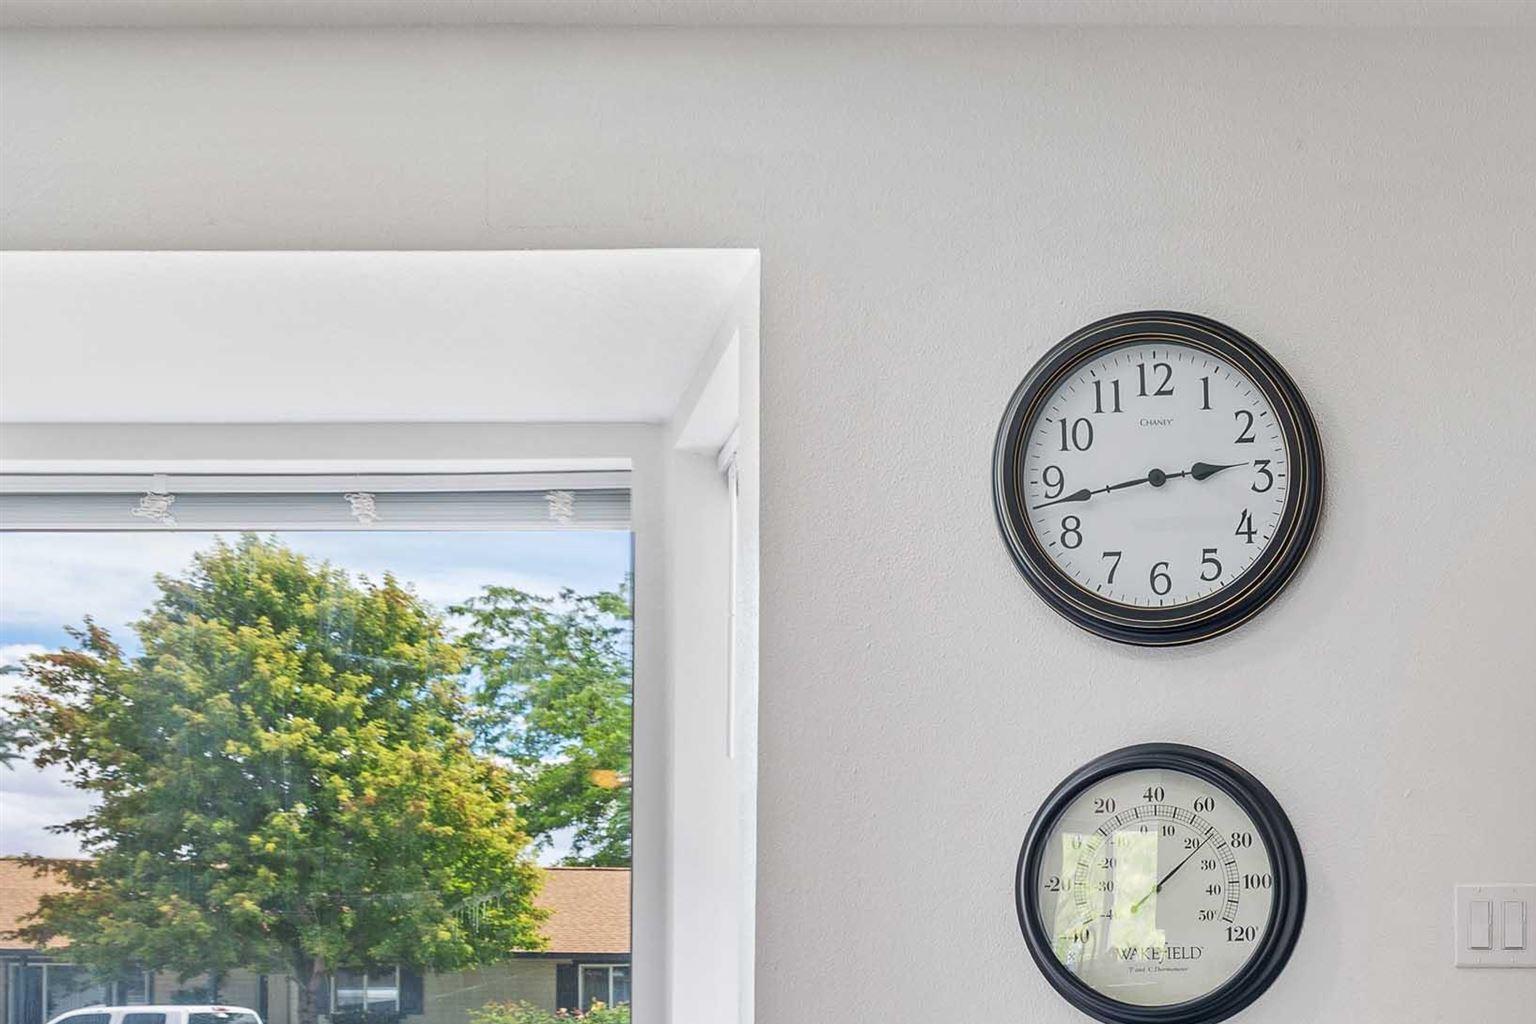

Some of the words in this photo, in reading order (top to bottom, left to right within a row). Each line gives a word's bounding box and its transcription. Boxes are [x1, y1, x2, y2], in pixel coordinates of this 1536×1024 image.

[1092, 379, 1123, 413] 11
[1136, 363, 1174, 396] 12
[1200, 377, 1212, 410] 1
[1058, 417, 1094, 451] 10
[1234, 410, 1256, 444] 2
[1042, 465, 1065, 499] 9
[1251, 459, 1273, 493] 3
[1060, 515, 1083, 549] 8
[1234, 508, 1258, 544] 4
[1102, 551, 1122, 584] 7
[1150, 562, 1172, 595] 6
[1200, 548, 1222, 581] 5
[1094, 798, 1115, 814] 20
[1143, 786, 1165, 802] 40
[1194, 796, 1215, 812] 60
[1162, 825, 1175, 836] 10
[1184, 838, 1200, 850] 20
[1230, 832, 1252, 848] 80
[1200, 860, 1216, 870] 30
[1243, 874, 1272, 889] 100
[1044, 875, 1071, 892] -20
[1205, 884, 1221, 896] 40
